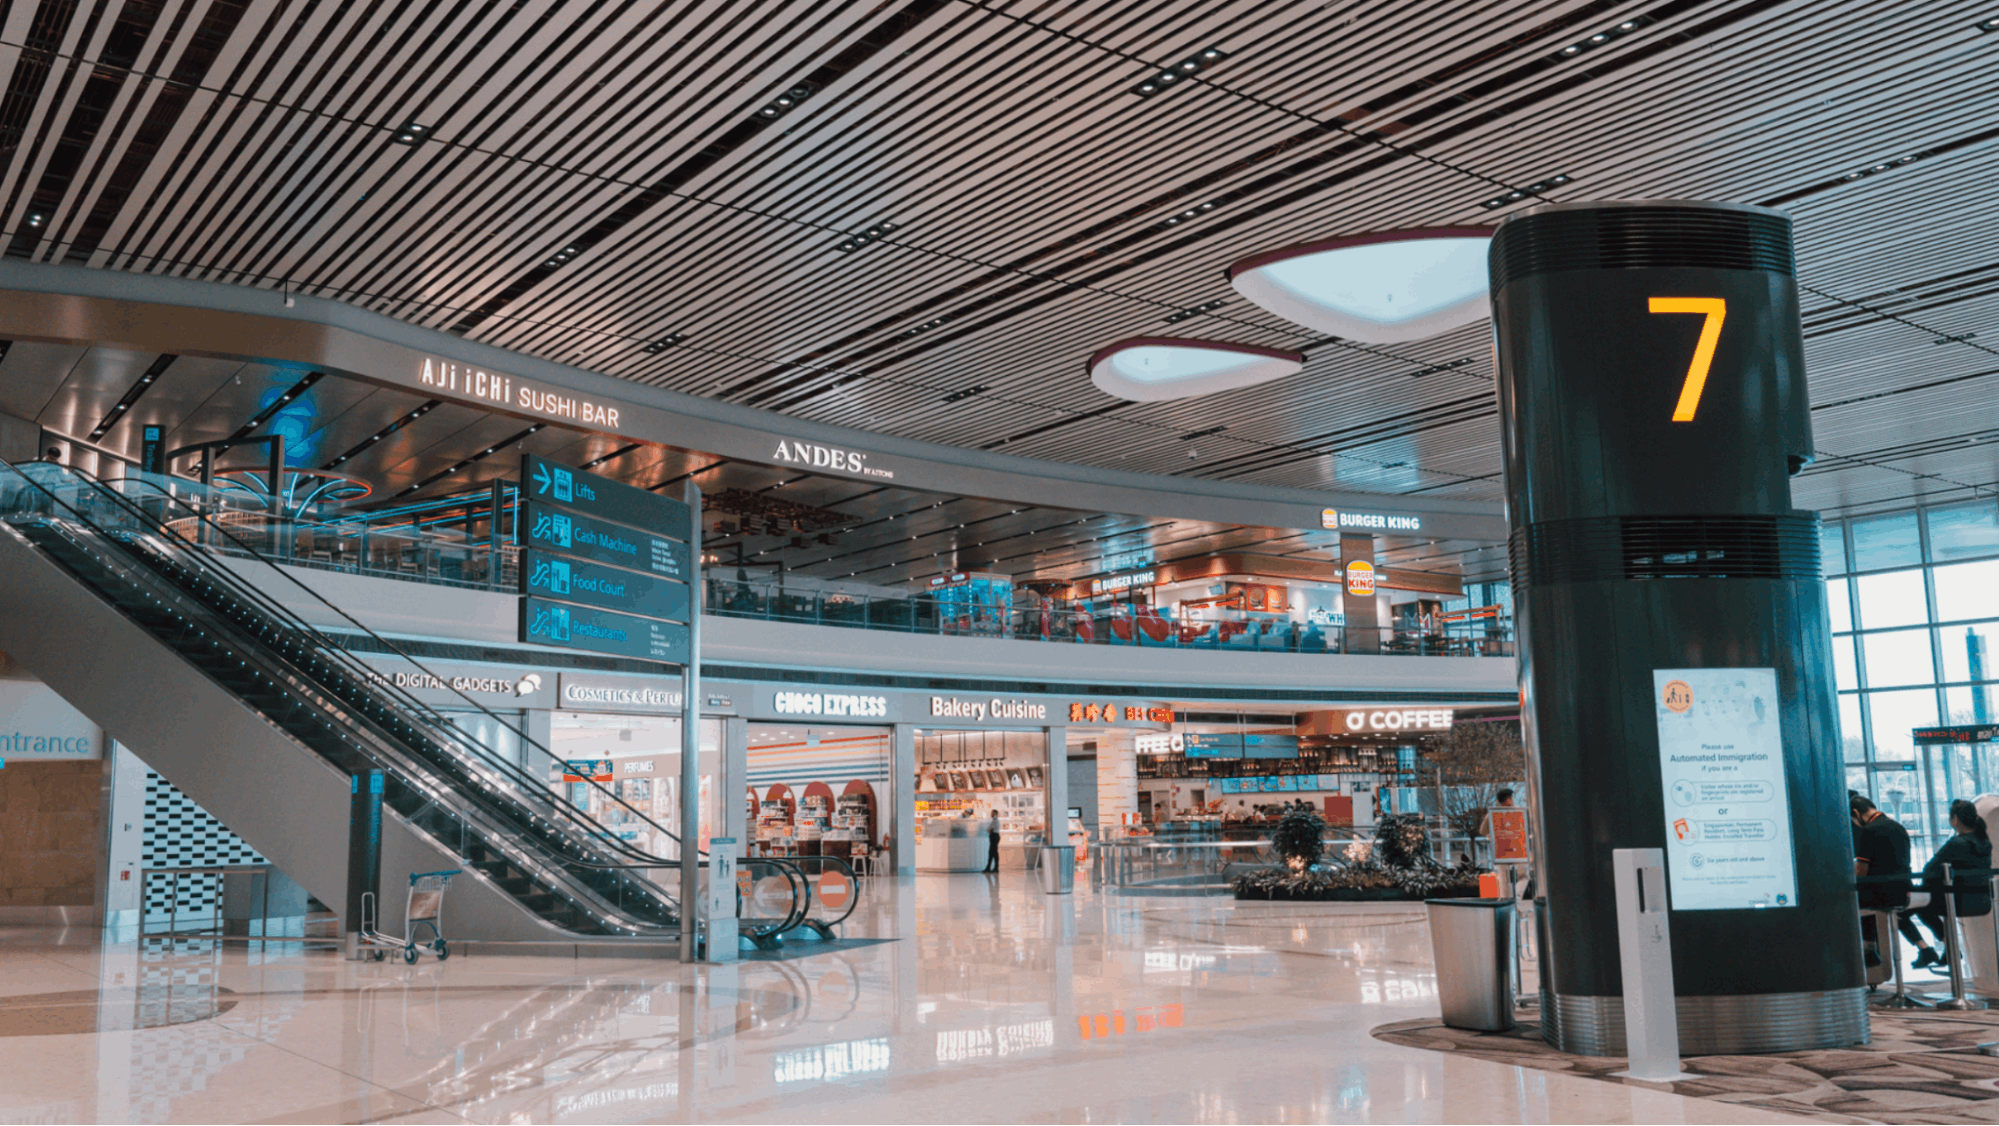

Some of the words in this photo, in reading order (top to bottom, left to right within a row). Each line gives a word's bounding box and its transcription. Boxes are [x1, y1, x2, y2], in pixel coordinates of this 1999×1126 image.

[1648, 297, 1726, 422] 7
[518, 386, 576, 419] SUSHI
[582, 401, 620, 429] BAR
[773, 440, 862, 473] ANDES
[575, 482, 596, 501] Lifts
[1340, 513, 1386, 529] BURGER
[1387, 516, 1420, 530] KING
[574, 527, 597, 545] Cash
[599, 533, 638, 555] Machine
[573, 575, 597, 592] Food
[599, 580, 625, 598] Court
[1102, 575, 1132, 590] BURGER
[1132, 571, 1155, 584] KING
[1348, 580, 1374, 588] KING
[573, 620, 627, 642] Restaurants
[396, 673, 447, 690] DIGITAL
[453, 676, 511, 693] GADGETS
[565, 684, 632, 702] COSMETICS
[643, 687, 683, 706] PERFU
[775, 691, 822, 714] CHOCO
[823, 694, 887, 717] EXPRESS
[931, 697, 986, 721] Bakery
[990, 698, 1046, 719] Cuisine
[1369, 710, 1453, 729] COFFEE
[1135, 735, 1171, 753] FFEE
[624, 760, 655, 773] PERFUMES
[1670, 753, 1716, 762] Automated
[1718, 752, 1768, 763] Immigration
[1718, 807, 1729, 816] or
